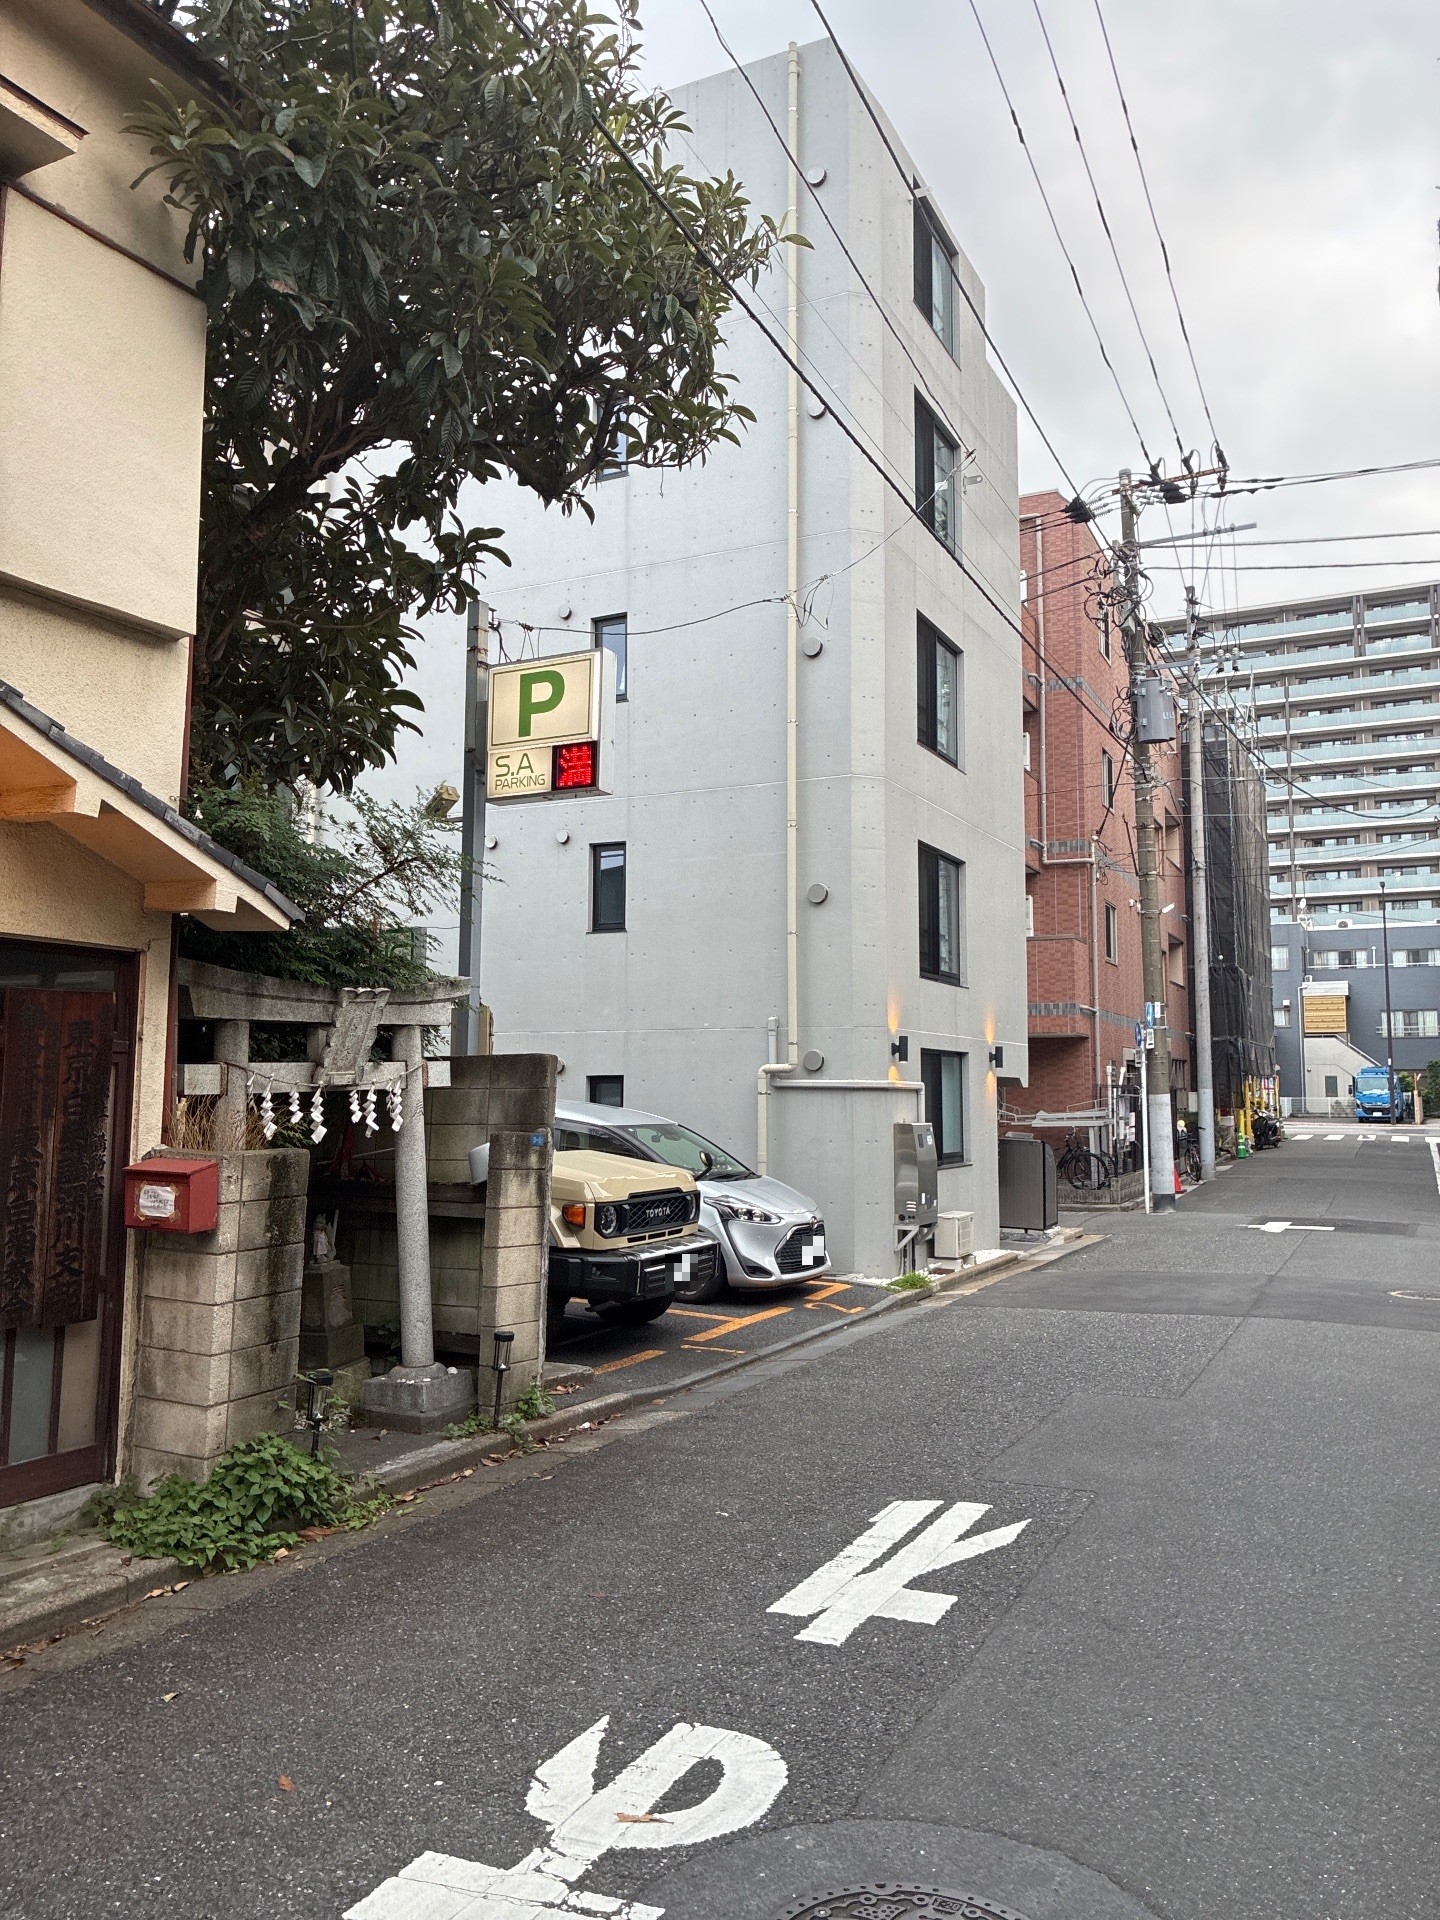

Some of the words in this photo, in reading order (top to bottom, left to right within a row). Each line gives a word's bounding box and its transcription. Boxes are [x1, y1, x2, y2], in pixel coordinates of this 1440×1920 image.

[518, 669, 565, 737] P
[495, 753, 534, 777] S.A
[559, 745, 592, 786] 満
[495, 774, 545, 790] PARKING
[645, 1206, 671, 1219] TOYOTA
